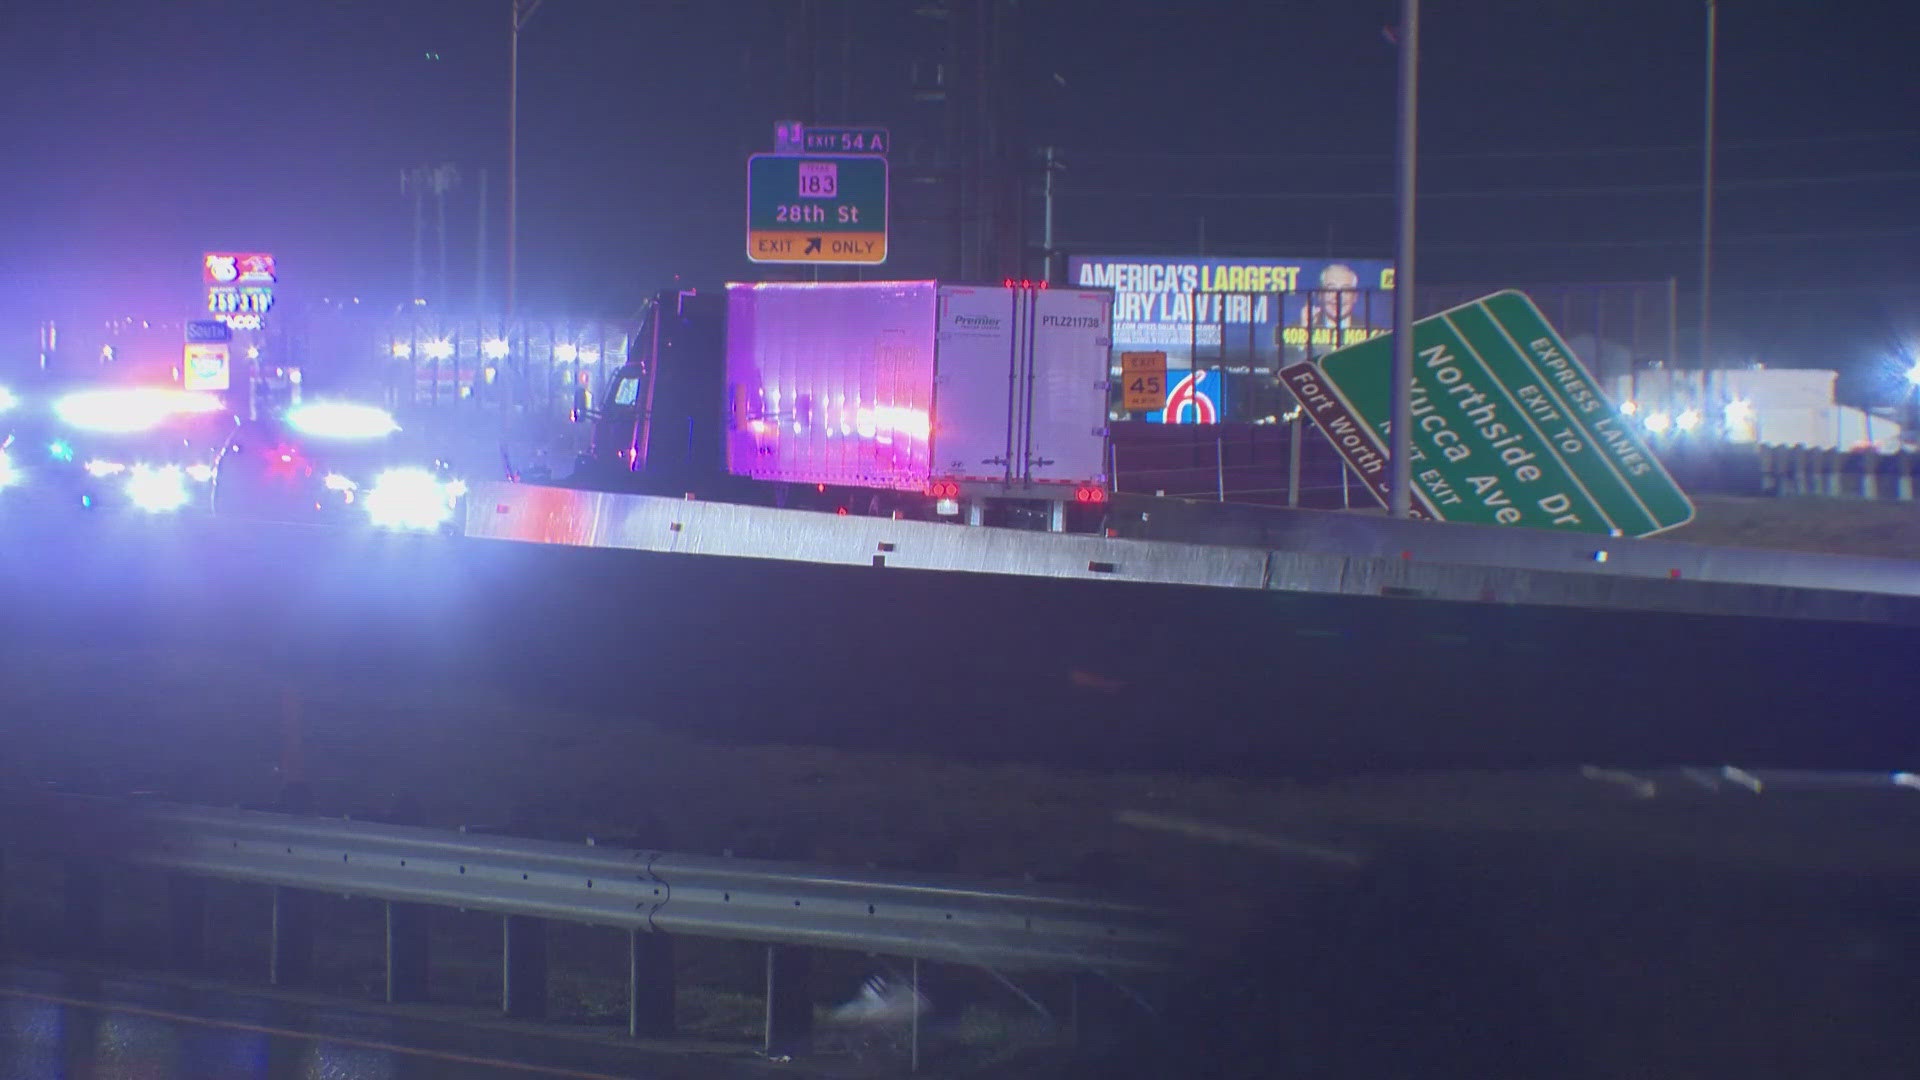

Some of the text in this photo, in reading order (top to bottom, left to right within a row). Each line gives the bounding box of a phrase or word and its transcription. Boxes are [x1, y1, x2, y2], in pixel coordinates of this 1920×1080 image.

[807, 133, 883, 150] EXIT 54 A
[801, 175, 834, 194] 183
[776, 204, 859, 223] 28th St
[758, 239, 874, 253] EXIT ONLY
[1079, 262, 1300, 294] AMERICA'S LARGEST
[1042, 315, 1099, 328] PTLZ211738
[1213, 294, 1268, 324] FIRM
[1130, 377, 1160, 394] 45
[1517, 384, 1583, 454] EXIT TO
[1530, 336, 1651, 477] EXPRESS LANES
[1293, 370, 1383, 475] Fort Worth
[1418, 343, 1581, 525] Northside Dr
[1419, 468, 1463, 506] EXIT
[1465, 474, 1522, 525] Ave
